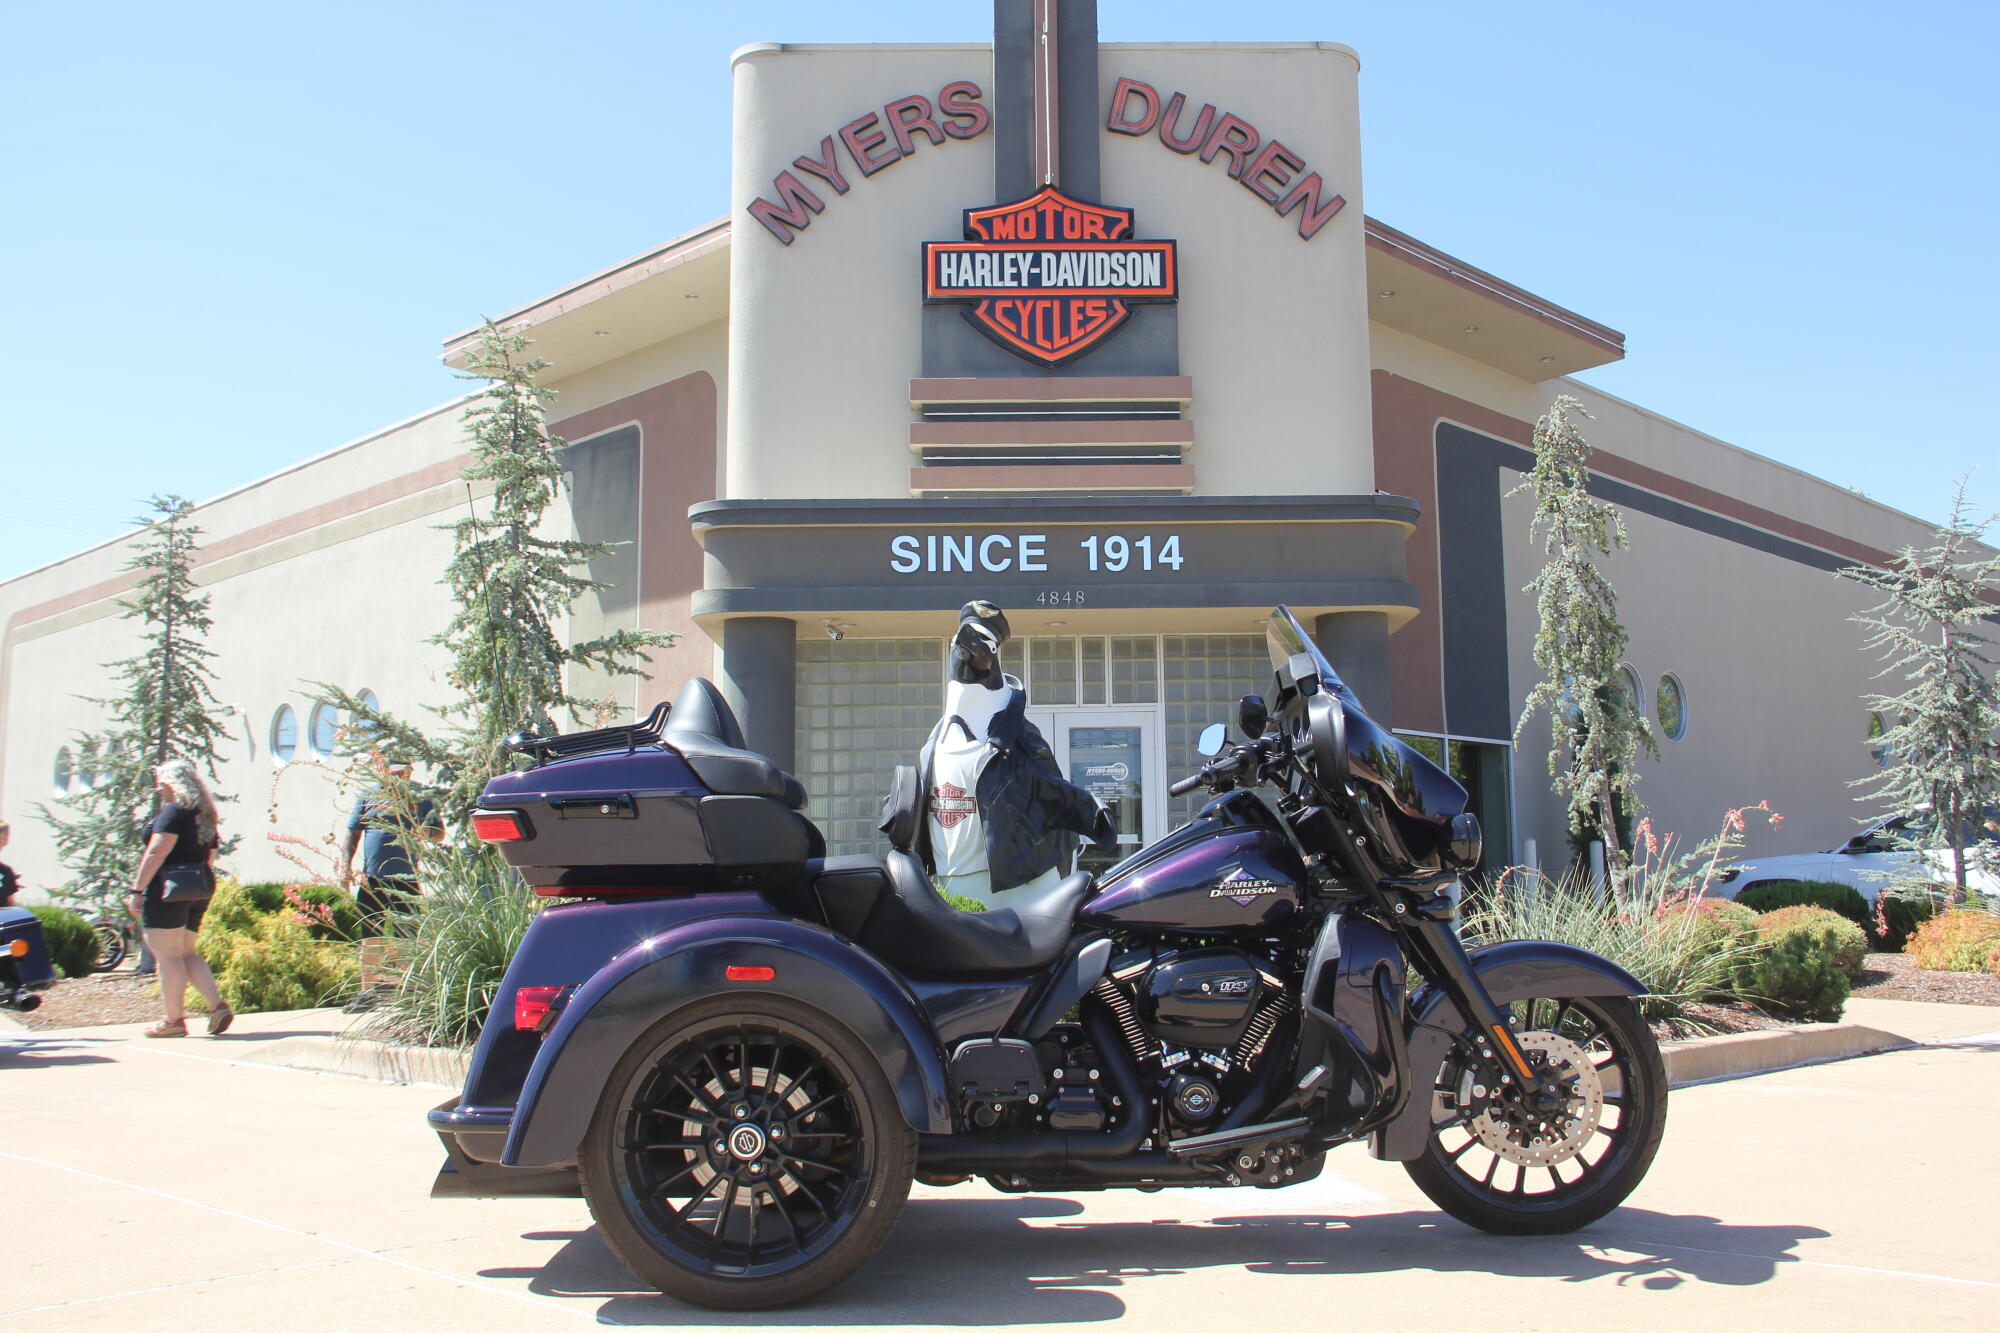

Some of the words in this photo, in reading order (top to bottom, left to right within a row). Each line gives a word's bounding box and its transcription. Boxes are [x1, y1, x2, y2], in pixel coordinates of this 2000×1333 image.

[746, 80, 990, 246] MYERS
[1107, 76, 1347, 241] DUREN
[992, 199, 1108, 240] MOTOR
[940, 251, 1161, 287] HARLEY-DAVIDSON
[995, 299, 1107, 350] CYCLES
[890, 534, 1047, 573] SINCE
[1081, 535, 1184, 571] 1914
[1036, 590, 1085, 605] 4848
[1209, 886, 1277, 898] DAVIDSON
[1218, 879, 1270, 890] HARLEY
